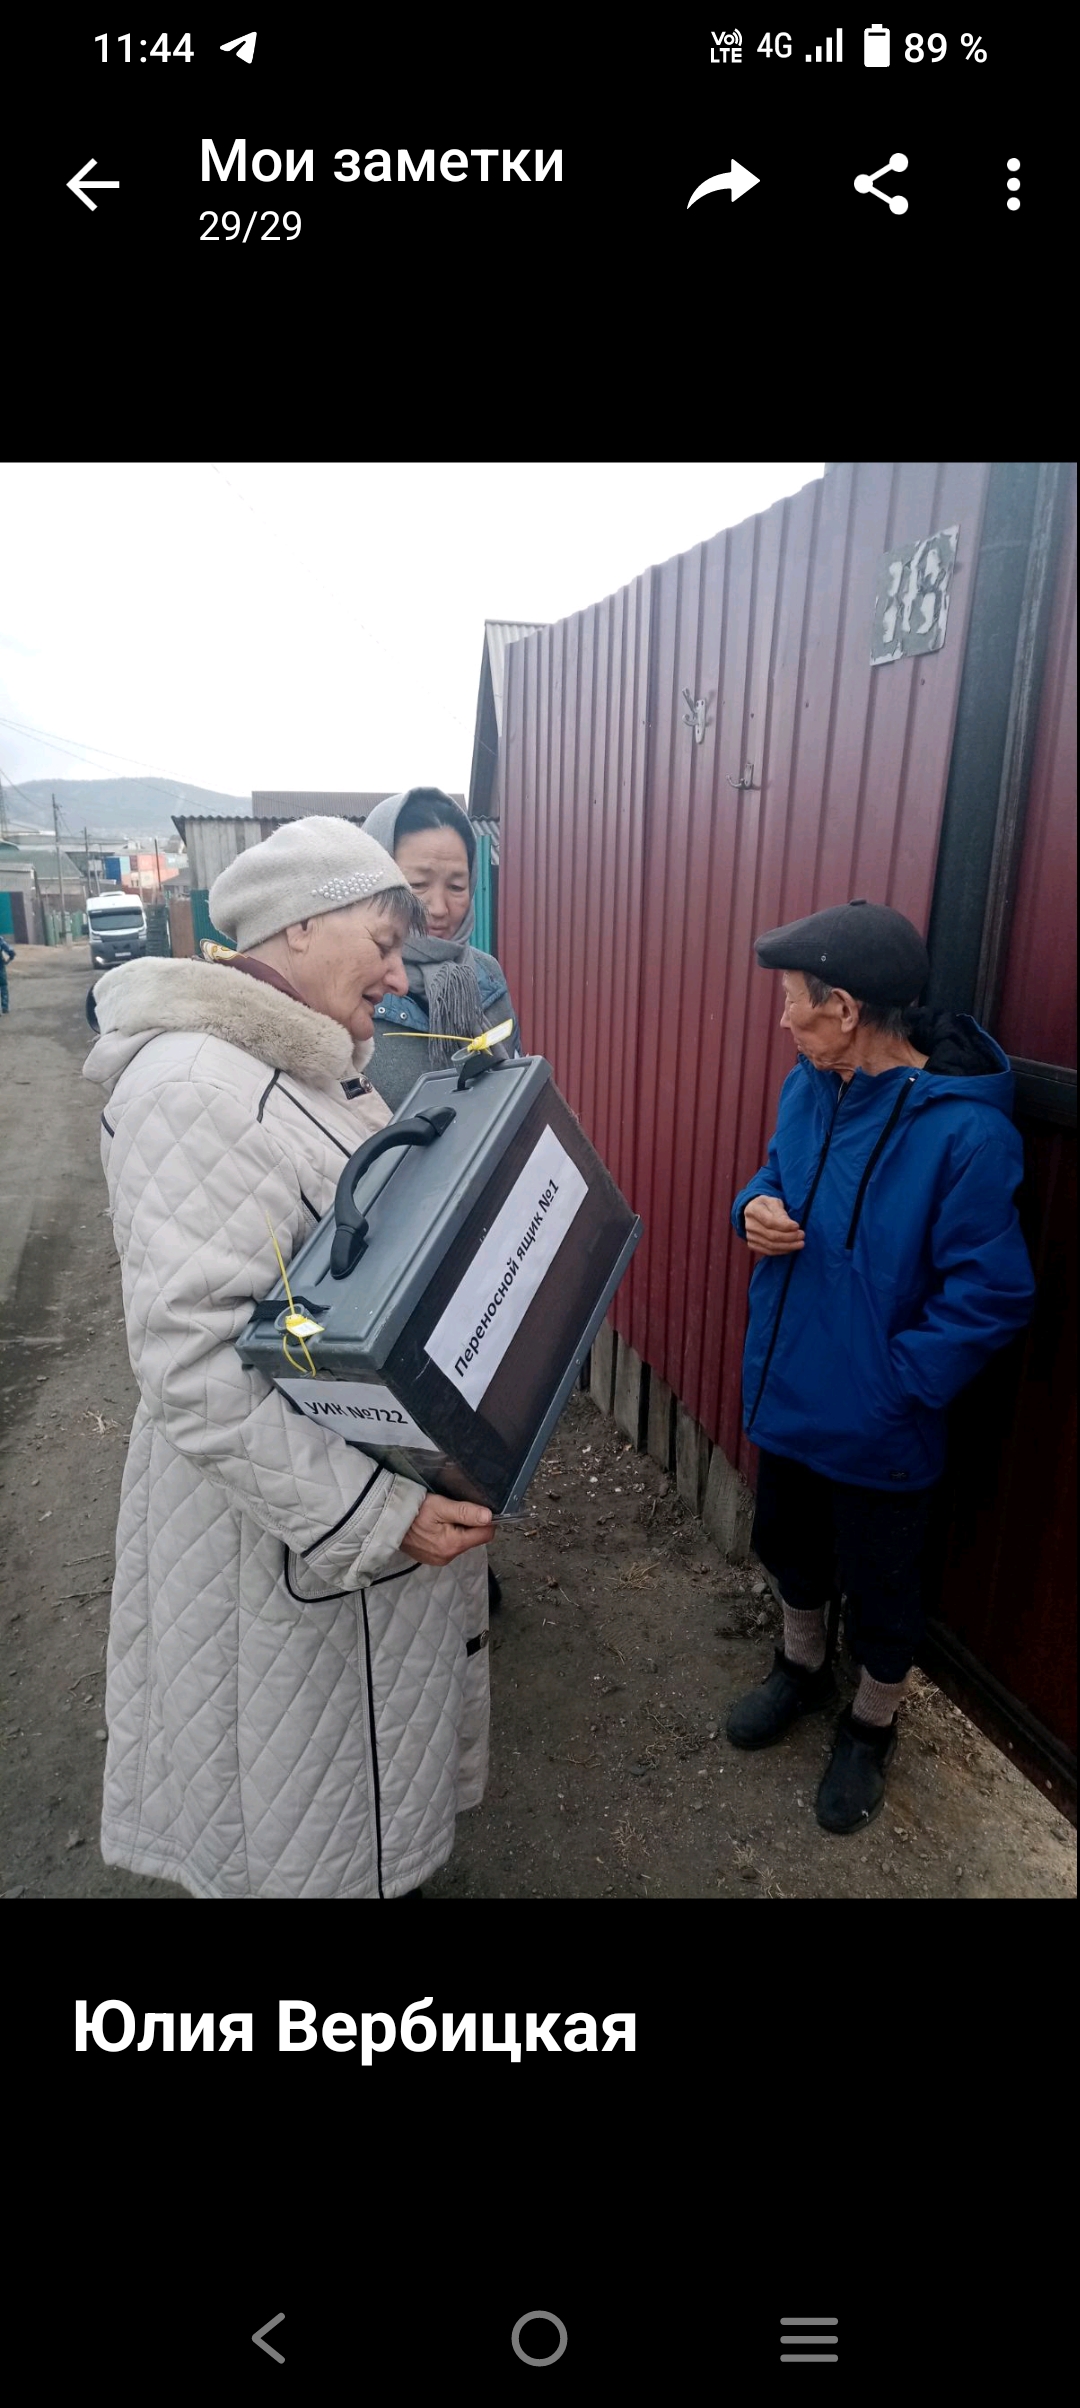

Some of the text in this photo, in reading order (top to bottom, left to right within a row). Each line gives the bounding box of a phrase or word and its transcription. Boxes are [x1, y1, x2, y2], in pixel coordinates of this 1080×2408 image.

[454, 1179, 559, 1378] Переносной ящик №1
[304, 1401, 408, 1424] УИК №722
